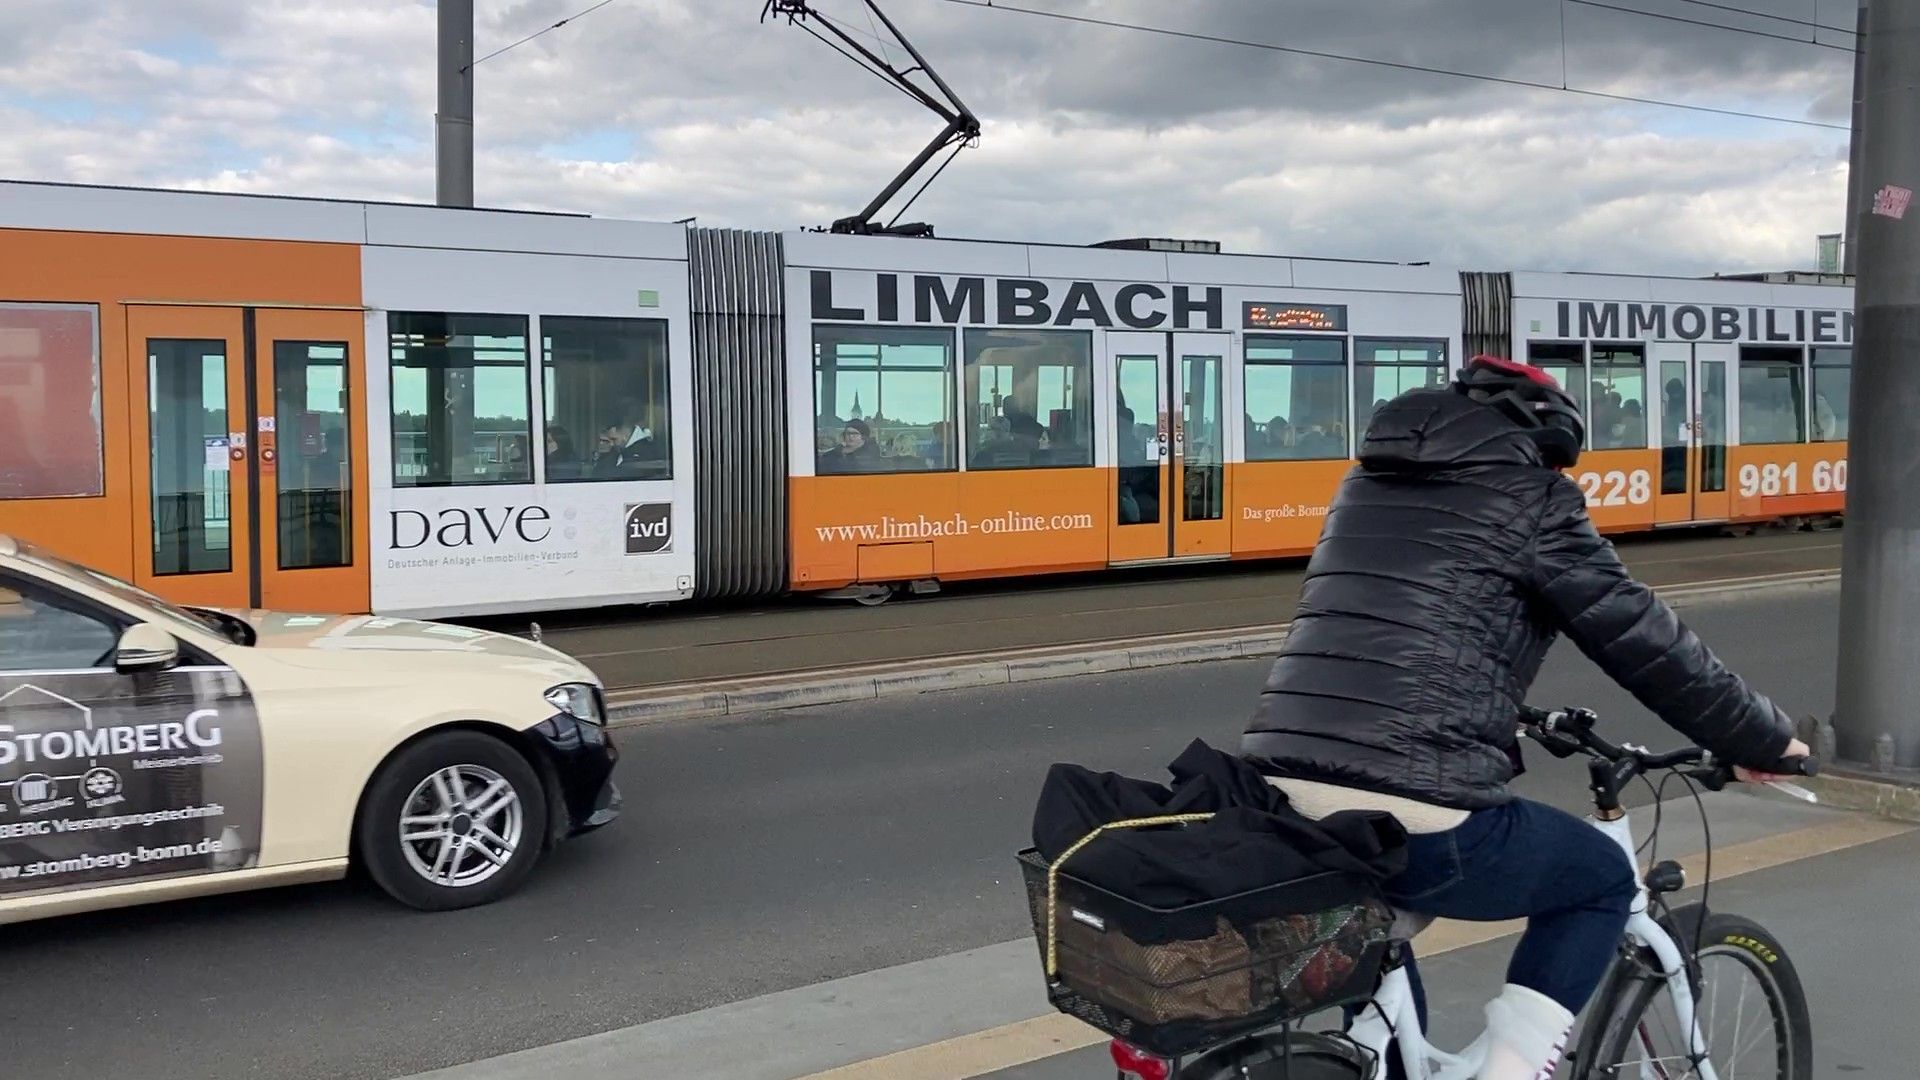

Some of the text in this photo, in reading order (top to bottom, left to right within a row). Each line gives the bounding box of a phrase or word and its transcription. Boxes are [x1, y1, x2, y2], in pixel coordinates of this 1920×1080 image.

[810, 270, 1222, 329] LIMBACH
[1564, 460, 1847, 507] 228 981 60
[1243, 507, 1262, 520] Das
[1265, 504, 1296, 522] große
[630, 517, 668, 538] ivd
[816, 511, 1093, 542] www.limbach-online.com
[388, 558, 439, 569] Deutscher
